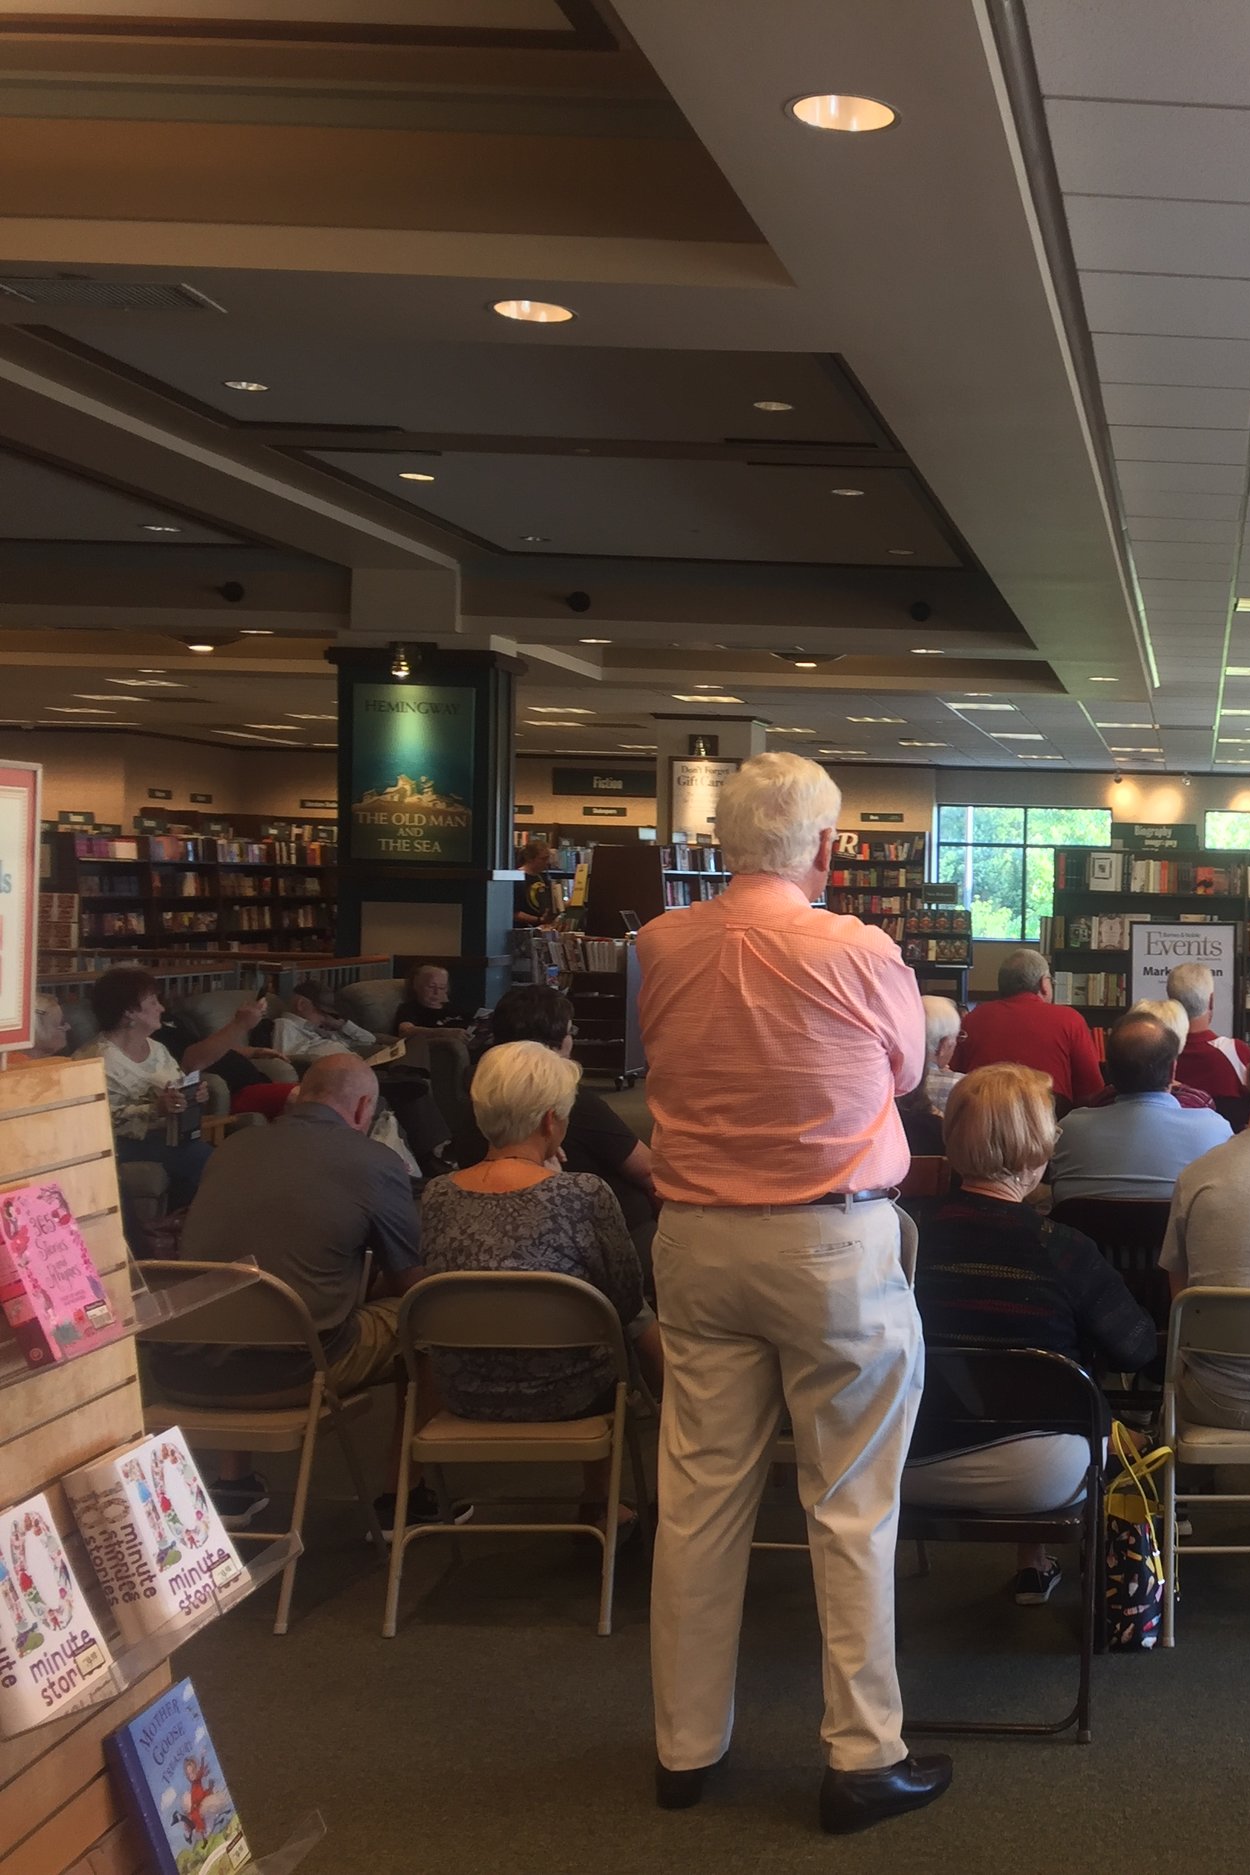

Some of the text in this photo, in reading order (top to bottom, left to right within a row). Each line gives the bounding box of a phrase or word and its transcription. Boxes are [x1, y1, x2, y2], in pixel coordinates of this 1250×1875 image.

[364, 700, 460, 715] HEMINGWAY
[592, 776, 624, 790] Fiction
[677, 775, 699, 788] Gift
[356, 811, 468, 828] THE OLD MAN
[396, 827, 424, 837] AND
[1134, 824, 1172, 839] Biography
[377, 838, 442, 853] THE SEA
[1144, 931, 1223, 957] Events
[1143, 966, 1172, 976] Mark
[29, 1213, 57, 1238] 365
[120, 1523, 157, 1599] minute
[168, 1548, 226, 1596] minute
[29, 1628, 92, 1684] minute
[139, 1698, 181, 1752] MOTHER
[152, 1721, 186, 1767] GOOSE
